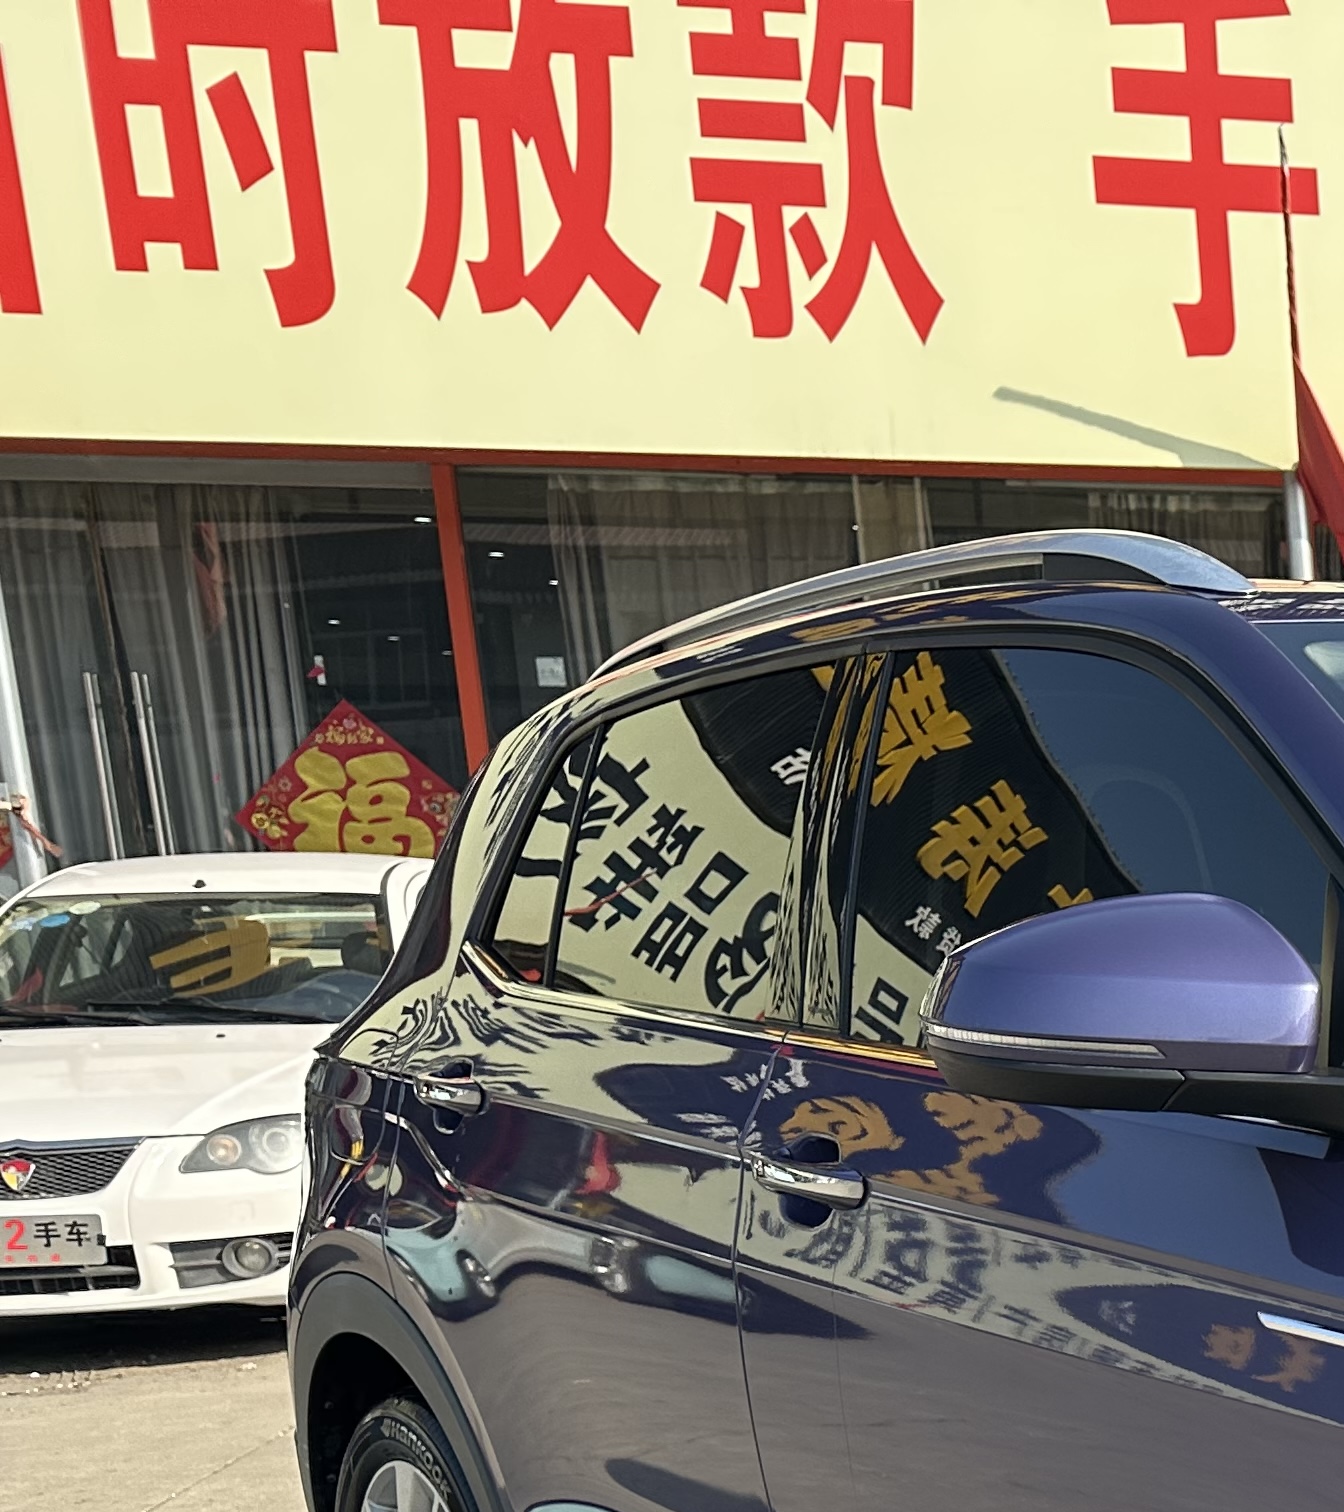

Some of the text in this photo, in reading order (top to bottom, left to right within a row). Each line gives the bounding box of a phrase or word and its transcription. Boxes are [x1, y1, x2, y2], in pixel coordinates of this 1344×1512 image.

[0, 0, 944, 345] 时放款
[288, 747, 436, 858] 福
